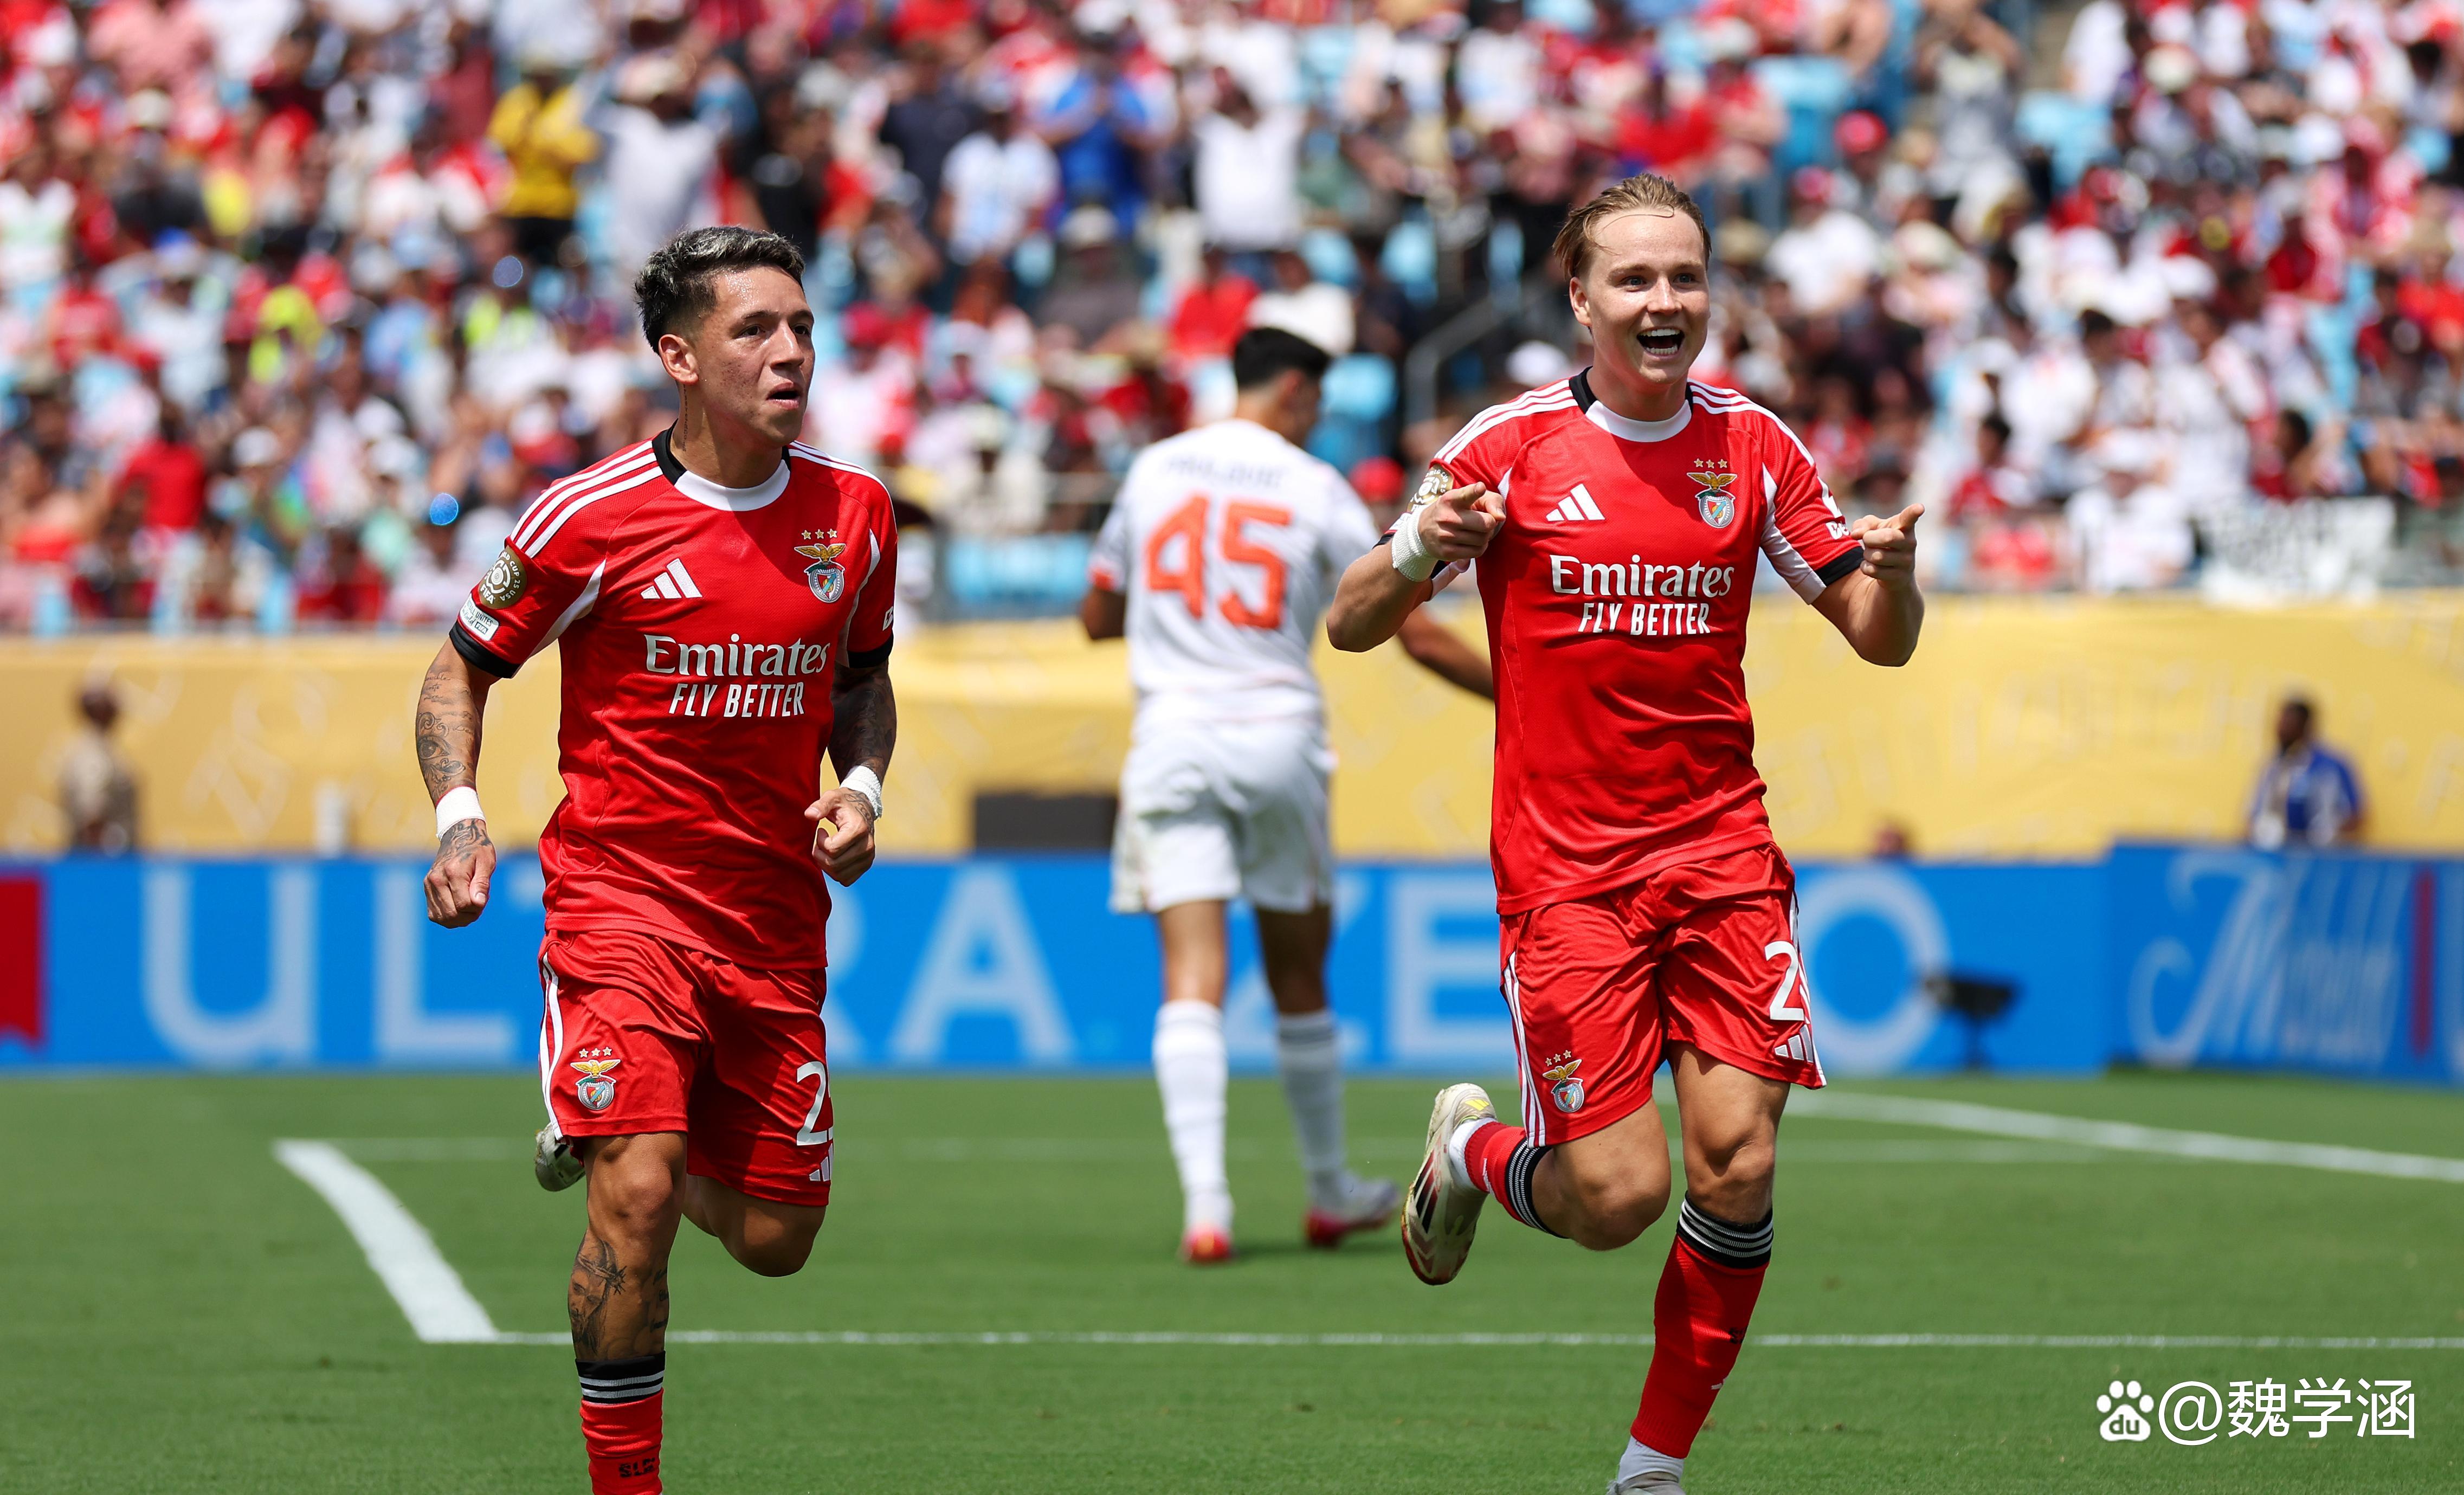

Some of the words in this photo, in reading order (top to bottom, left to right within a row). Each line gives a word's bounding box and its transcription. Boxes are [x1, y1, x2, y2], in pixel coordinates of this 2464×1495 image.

[509, 560, 520, 576] CUP
[1147, 493, 1295, 630] 45
[513, 579, 520, 589] 25
[1550, 554, 1734, 598] Emirates
[480, 584, 494, 604] FIFA
[500, 590, 515, 601] USA
[476, 611, 493, 627] UNITES
[476, 622, 488, 634] FIFA
[1578, 602, 1623, 633] FLY
[1630, 603, 1711, 636] BETTER
[644, 633, 830, 676] Emirates
[669, 683, 718, 717] FLY
[724, 682, 804, 717] BETTER
